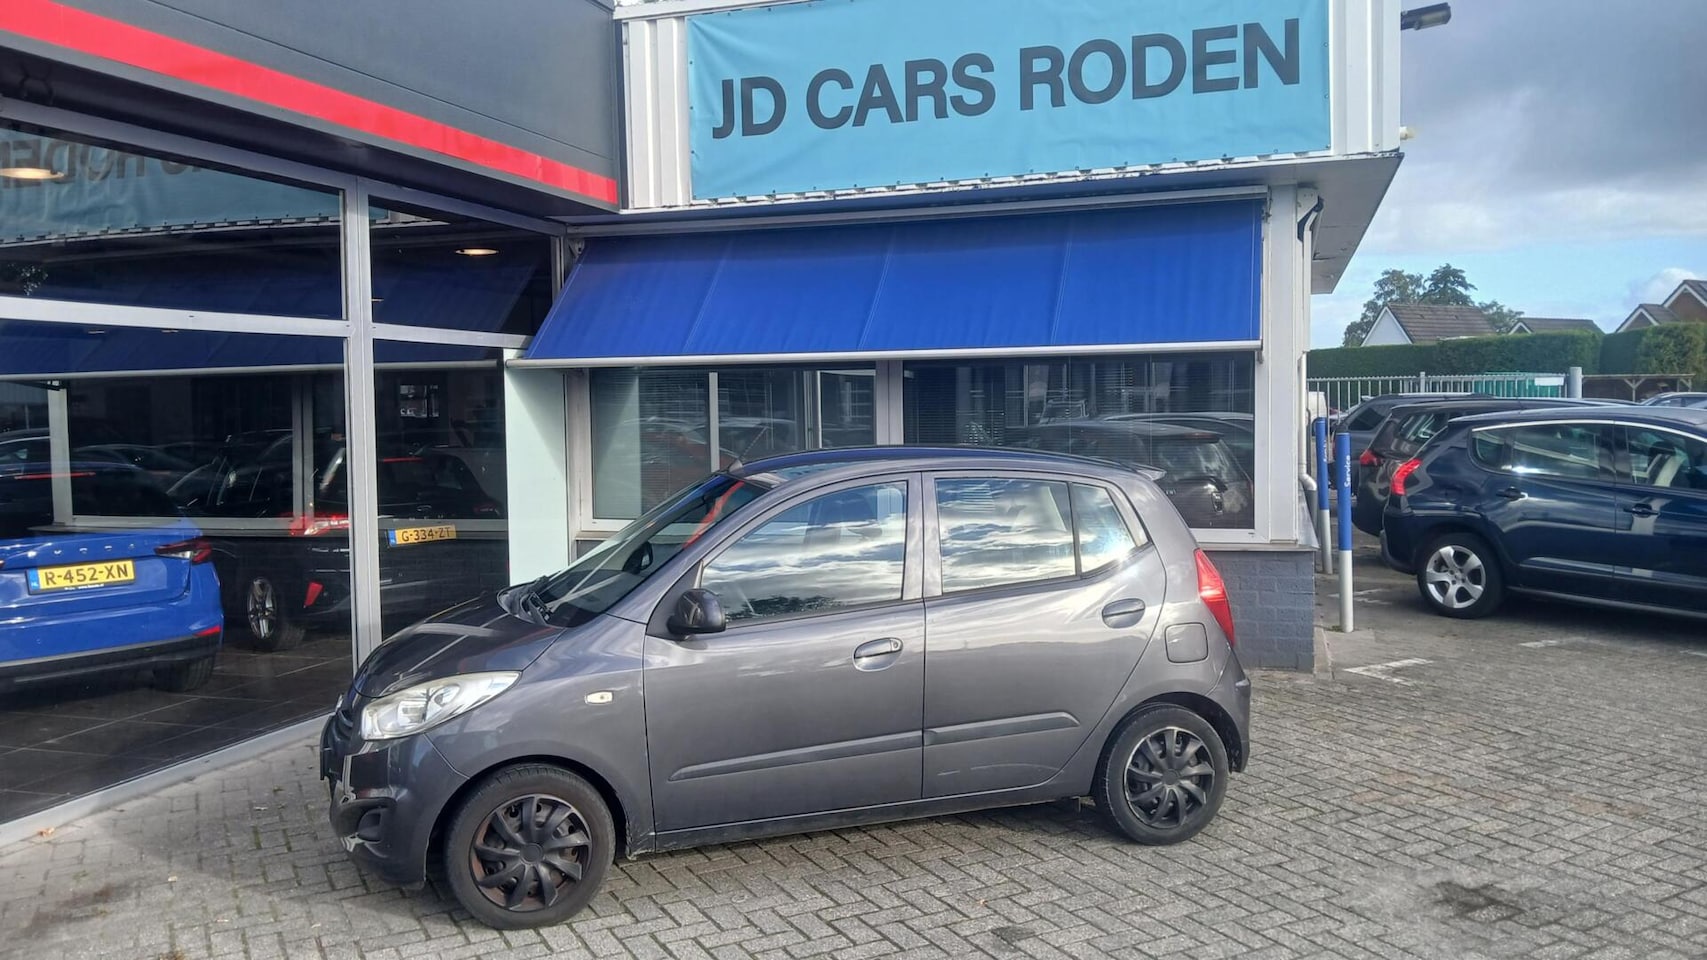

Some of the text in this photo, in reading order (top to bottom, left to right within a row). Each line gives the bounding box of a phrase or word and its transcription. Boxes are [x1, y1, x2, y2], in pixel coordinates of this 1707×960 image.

[712, 18, 1301, 140] JD CARS RODEN
[1343, 454, 1351, 488] Service
[401, 526, 451, 542] G-334-ZT
[44, 563, 129, 586] R-452-XN
